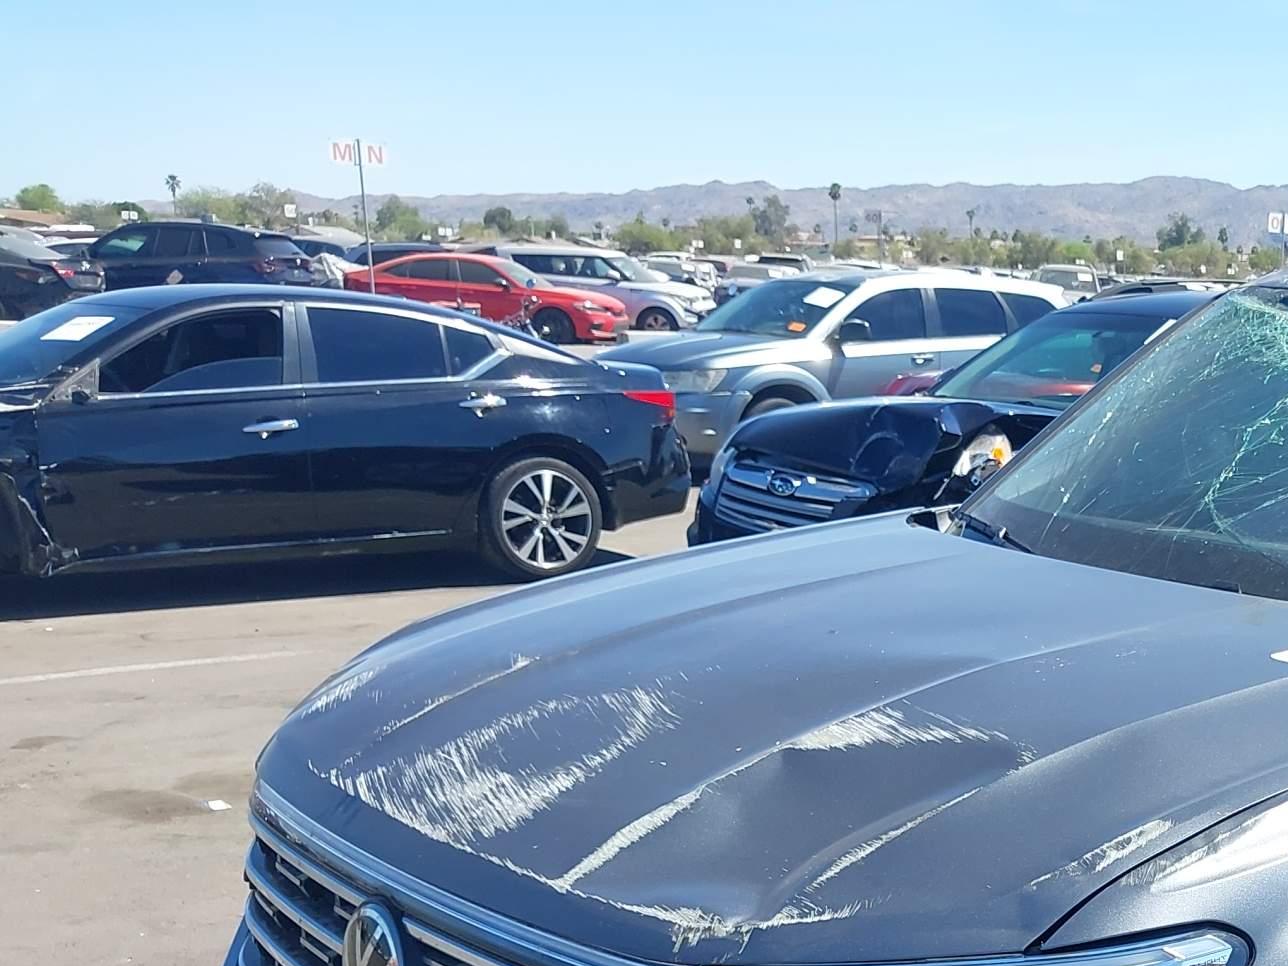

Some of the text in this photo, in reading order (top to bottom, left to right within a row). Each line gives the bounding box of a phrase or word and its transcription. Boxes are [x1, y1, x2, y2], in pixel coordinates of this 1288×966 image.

[332, 143, 353, 161] M
[367, 145, 383, 164] N
[1271, 217, 1280, 230] O
